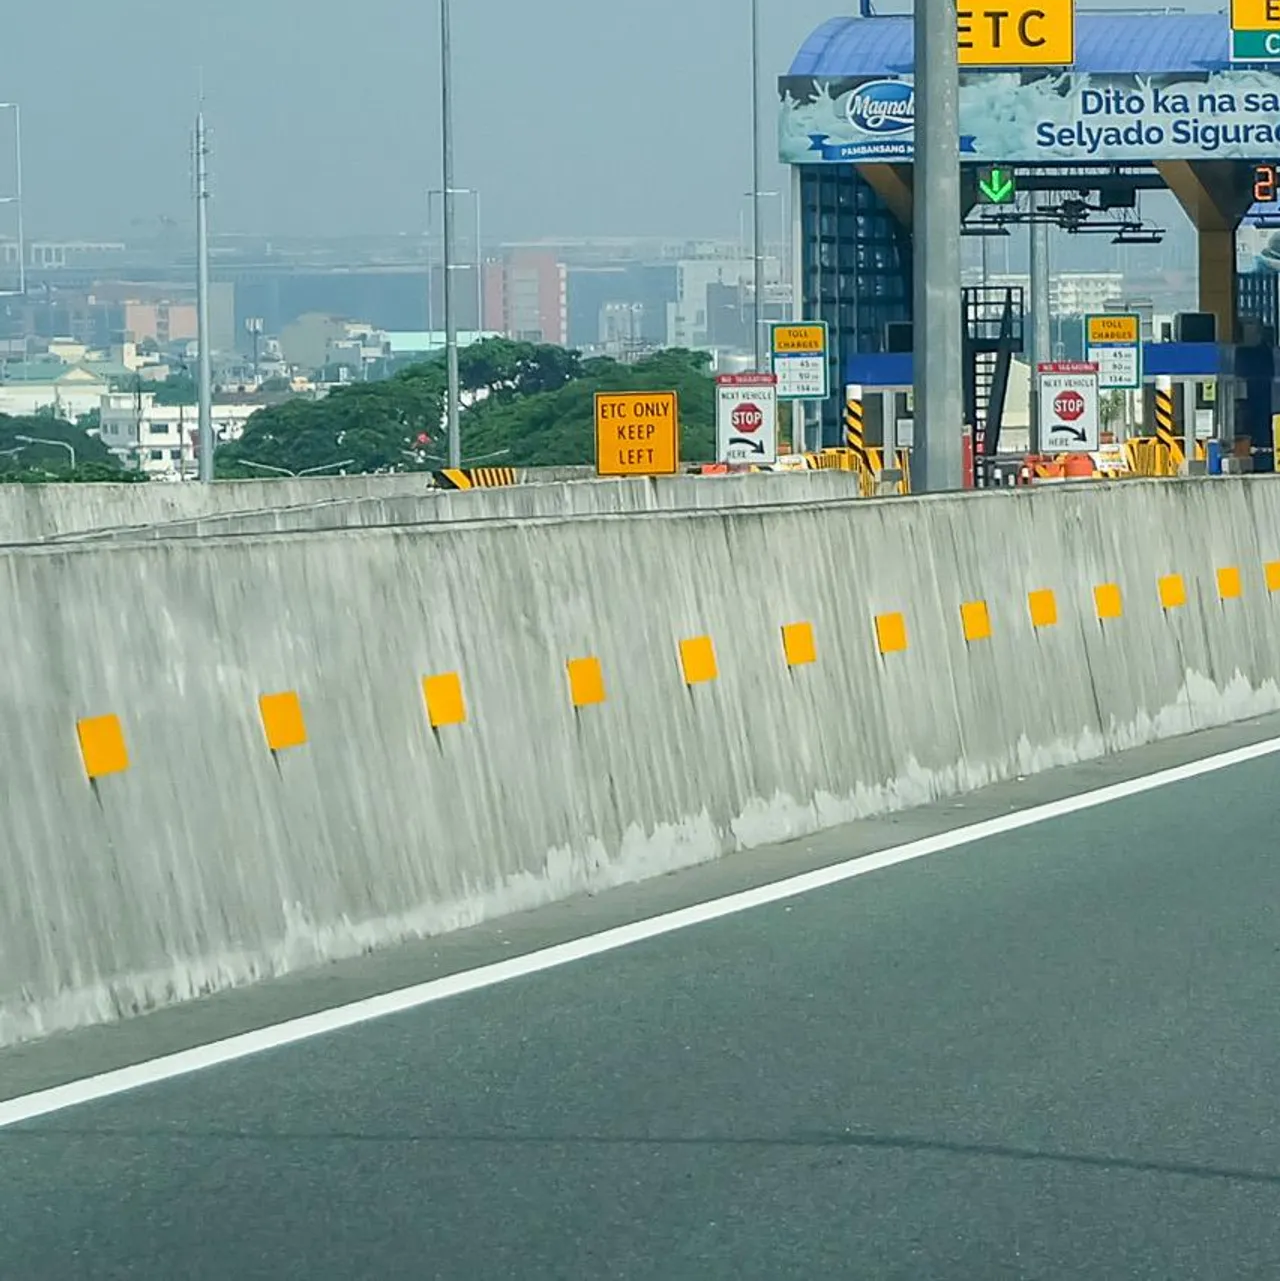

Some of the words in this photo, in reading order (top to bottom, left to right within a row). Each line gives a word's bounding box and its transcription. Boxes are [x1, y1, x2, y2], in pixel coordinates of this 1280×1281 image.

[956, 10, 1047, 48] ETC
[849, 91, 914, 128] Magnol
[1081, 89, 1145, 116] Dito
[1152, 88, 1190, 114] ka
[1198, 94, 1237, 114] na
[1244, 93, 1280, 113] sa
[1036, 122, 1163, 154] Selyado
[1255, 166, 1274, 201] 2
[601, 404, 626, 418] ETC
[634, 402, 670, 417] ONLY
[1054, 399, 1083, 412] STOP
[732, 411, 762, 425] STOP
[617, 425, 655, 440] KEEP
[619, 449, 654, 465] LEFT
